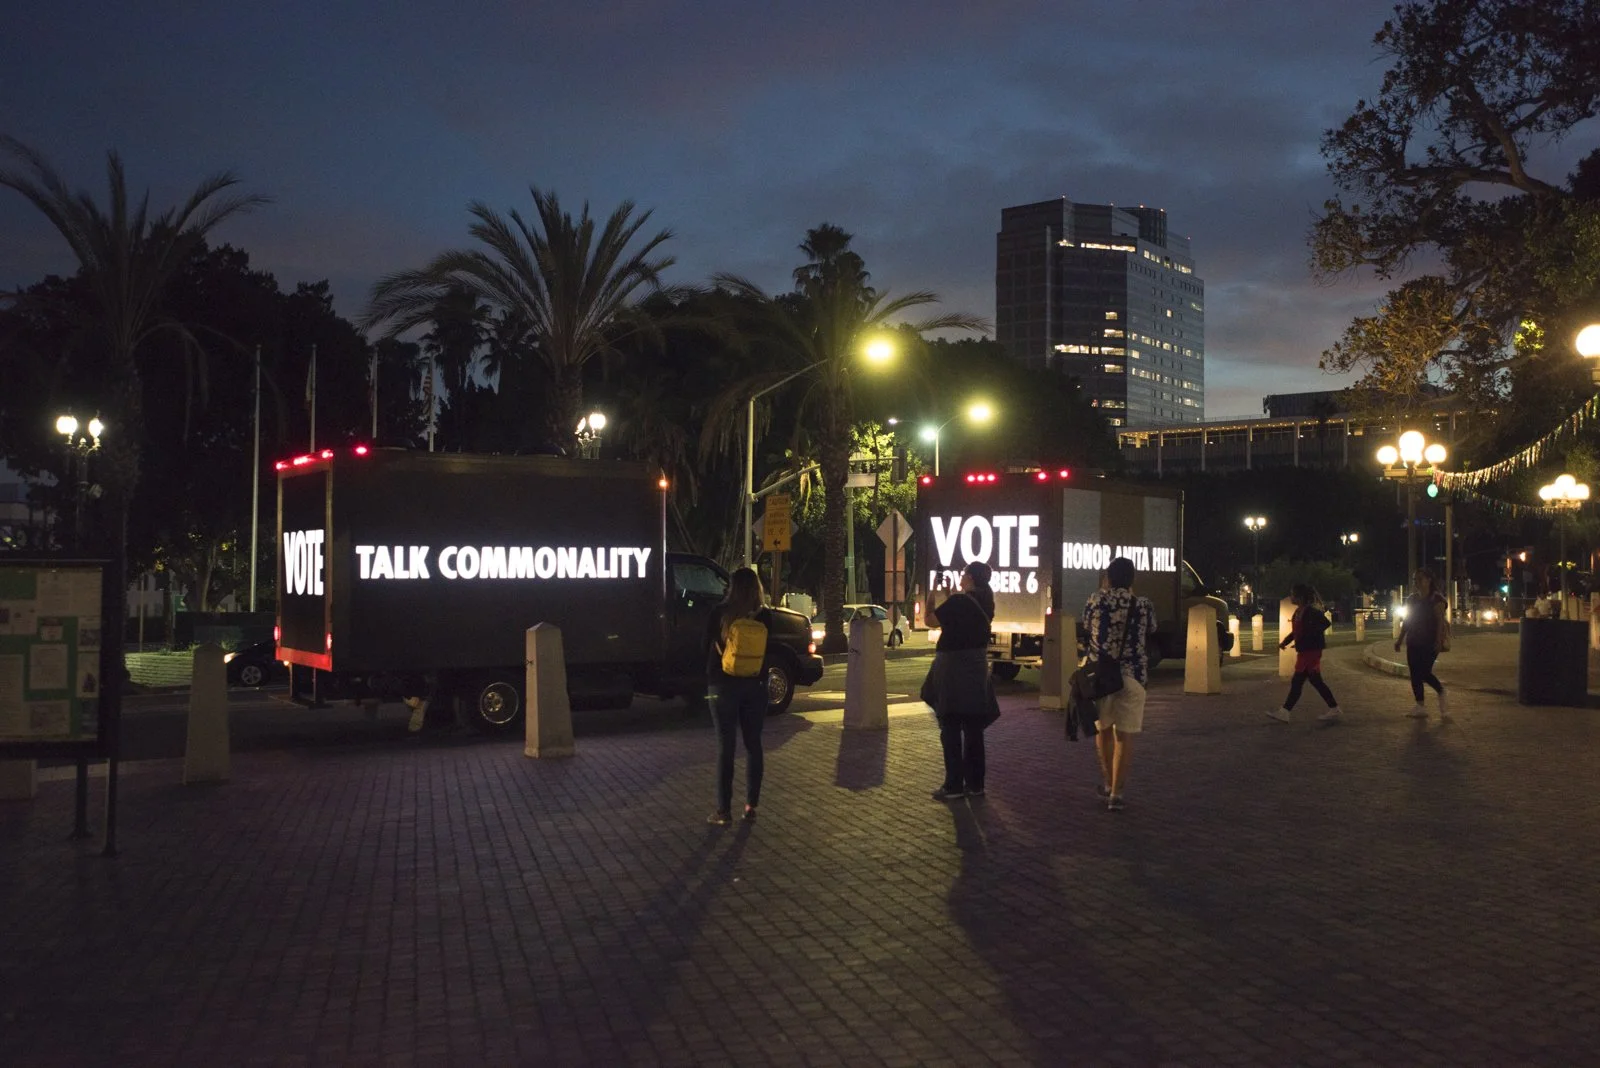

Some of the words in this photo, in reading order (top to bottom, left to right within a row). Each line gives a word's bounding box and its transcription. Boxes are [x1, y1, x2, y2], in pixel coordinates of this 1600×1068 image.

[930, 514, 1039, 566] VOTE
[1063, 542, 1112, 571] HONOR
[1153, 547, 1177, 573] HILL
[284, 529, 324, 596] VOTE
[356, 545, 431, 580] TALK
[438, 545, 651, 580] COMMONALITY
[930, 570, 1021, 592] OVBER
[1026, 571, 1038, 593] 6
